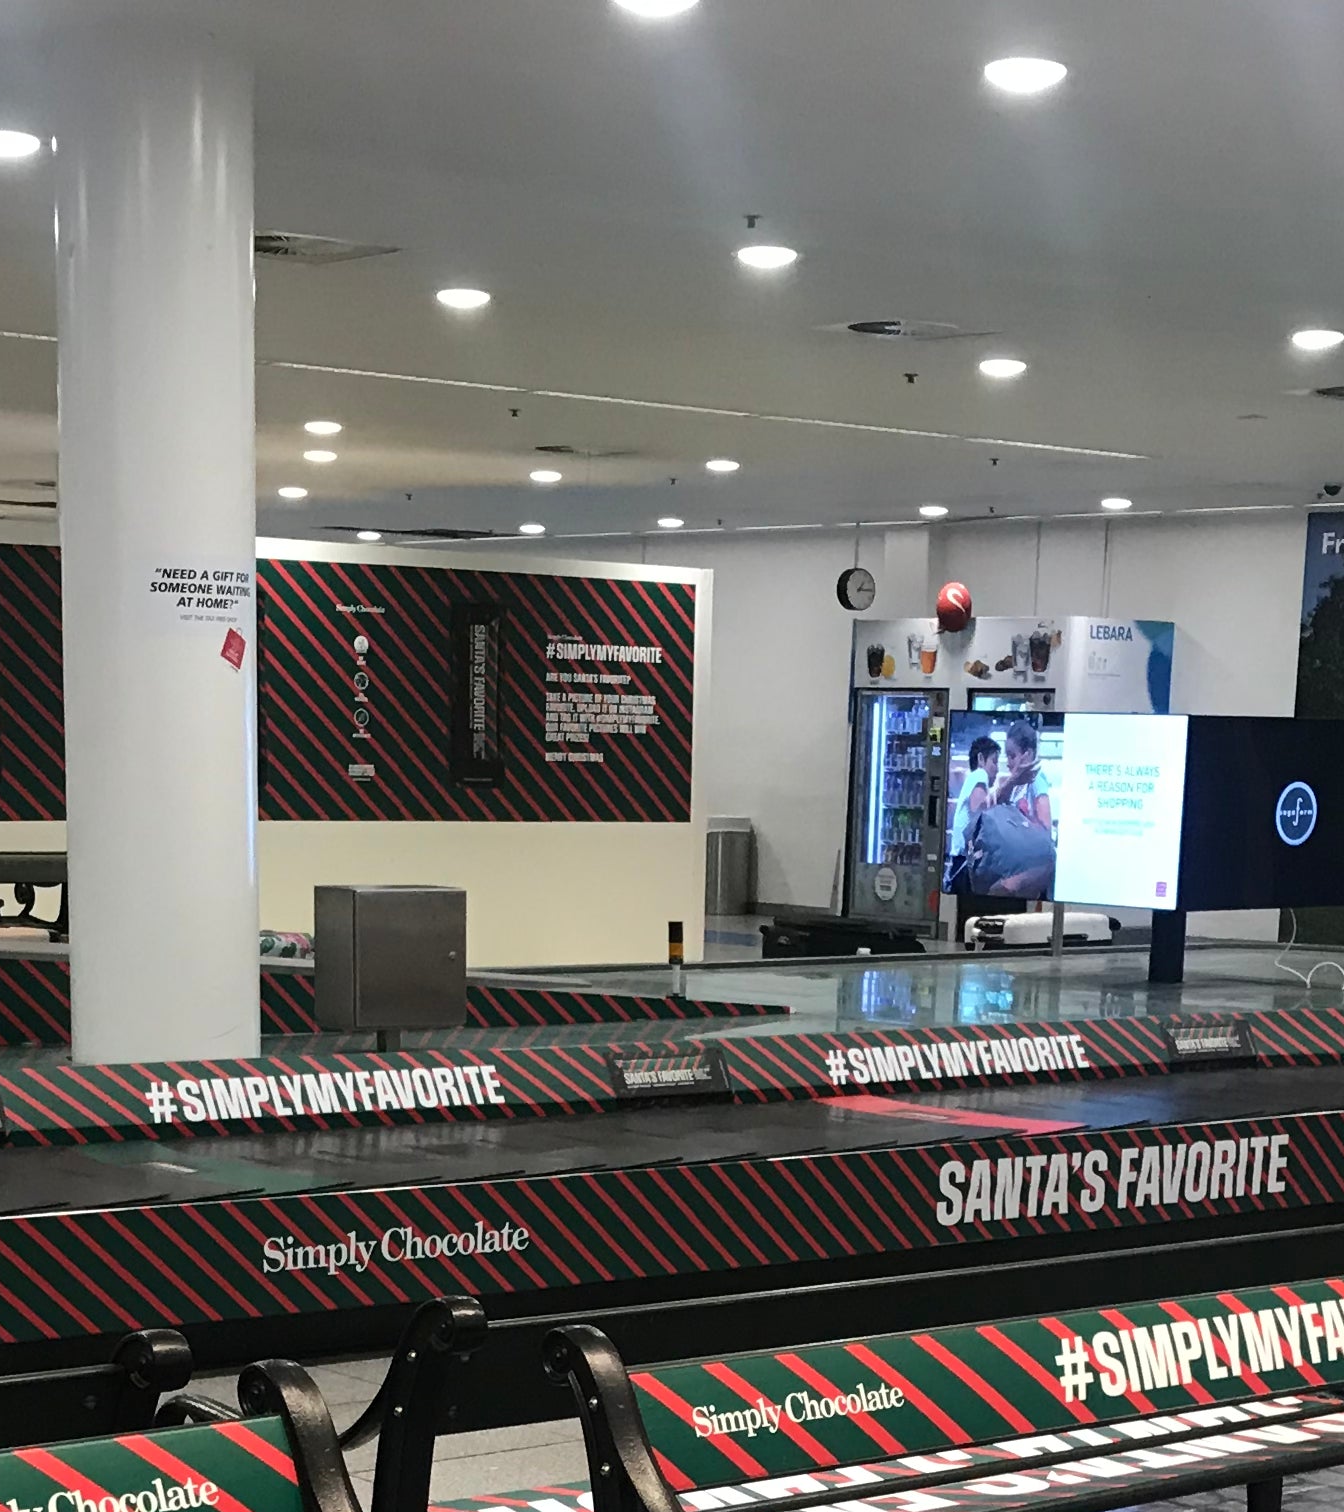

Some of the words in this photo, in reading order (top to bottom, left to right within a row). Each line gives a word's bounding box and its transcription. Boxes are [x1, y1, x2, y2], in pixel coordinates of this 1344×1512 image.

[200, 570, 209, 580] A
[213, 571, 234, 582] GIFT
[236, 573, 249, 583] FOR
[150, 582, 213, 594] SOMEONE
[176, 597, 194, 607] AT
[1089, 625, 1133, 641] LEBARA
[546, 643, 662, 663] #SIMPLYMYFAVORITE
[1125, 765, 1160, 777] ALWAYS
[1089, 781, 1095, 791] A
[1098, 781, 1134, 793] REASON
[1136, 783, 1154, 793] FOR
[1097, 797, 1143, 810] SHOPPING
[825, 1034, 1089, 1086] #SIMPLYMYFAVORITE
[145, 1065, 505, 1124] #SIMPLYMYFAVORITE
[936, 1149, 1108, 1227] SANTA'S
[1117, 1134, 1290, 1209] FAVORITE
[263, 1230, 377, 1276] Simply
[381, 1220, 530, 1263] Chocolate
[692, 1397, 782, 1438] Simply
[784, 1382, 905, 1424] Chocolate
